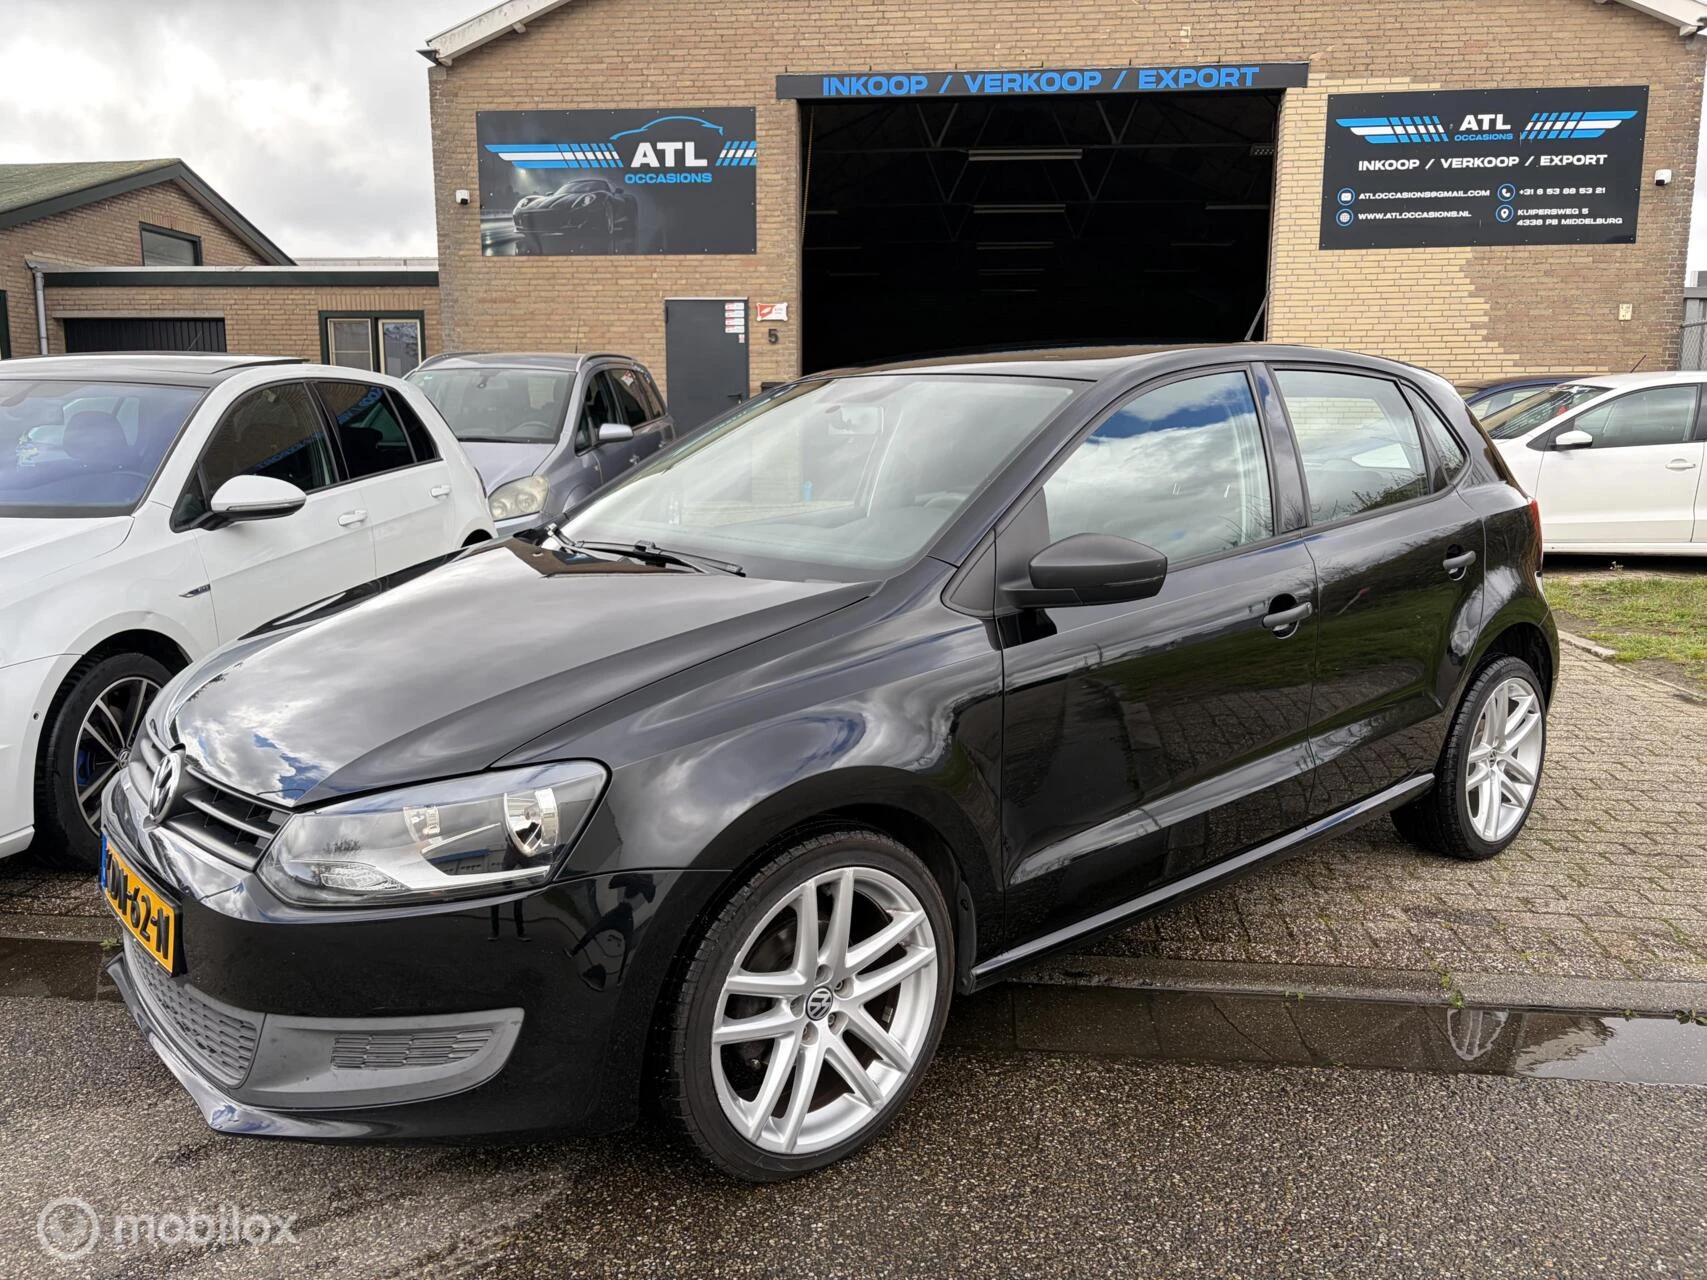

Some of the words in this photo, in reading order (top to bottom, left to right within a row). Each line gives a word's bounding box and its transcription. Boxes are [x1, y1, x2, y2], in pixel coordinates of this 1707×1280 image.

[823, 75, 928, 97] INKOOP
[939, 75, 953, 95] /
[964, 71, 1102, 93] VERKOOP
[1113, 71, 1128, 90] /
[1138, 66, 1259, 89] EXPORT
[1459, 114, 1512, 132] ATL
[1454, 132, 1514, 142] OCCASIONS
[630, 141, 708, 168] ATL
[1358, 159, 1420, 171] INKOOP
[1425, 158, 1435, 170] /
[1440, 156, 1519, 169] VERKOOP
[1525, 155, 1534, 167] /
[1539, 154, 1608, 167] EXPORT
[624, 172, 713, 185] OCCASIONS
[1358, 189, 1490, 200] ATLOCCASIONS@GMAIL.COM
[1519, 188, 1534, 196] +31
[1545, 188, 1559, 196] 53
[1578, 187, 1592, 195] 53
[1595, 186, 1606, 194] 21
[1358, 211, 1472, 220] WWW.ATLOCCASIONS.NL
[1517, 208, 1579, 216] KUIPERSWEG
[1545, 218, 1559, 226] PB
[1561, 217, 1623, 226] MIDDELBURG
[768, 328, 779, 344] 5
